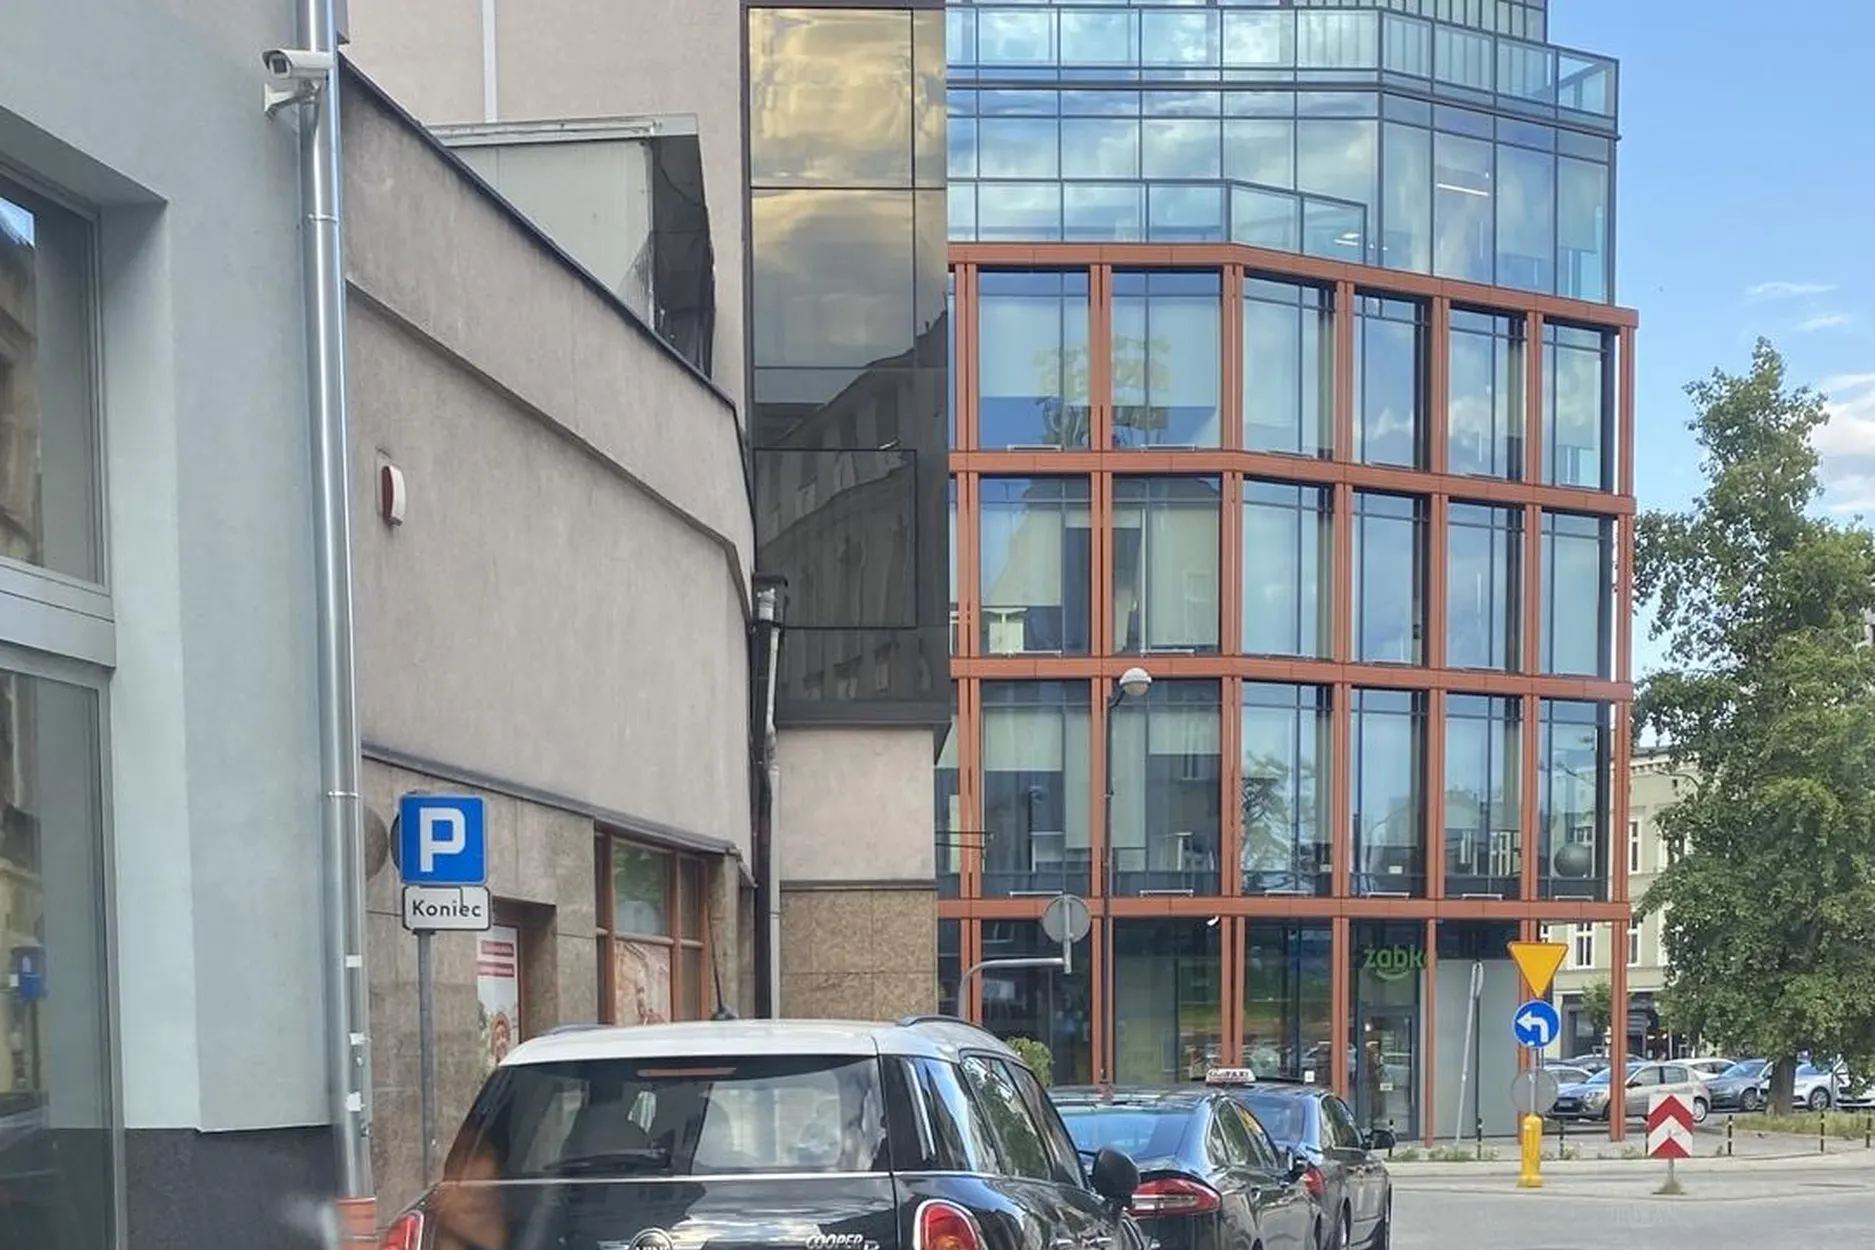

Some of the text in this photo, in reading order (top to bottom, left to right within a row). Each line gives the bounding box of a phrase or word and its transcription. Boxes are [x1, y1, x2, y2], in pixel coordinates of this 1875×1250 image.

[420, 807, 466, 873] P
[411, 900, 482, 918] Koniec
[805, 1233, 863, 1250] COOPER
